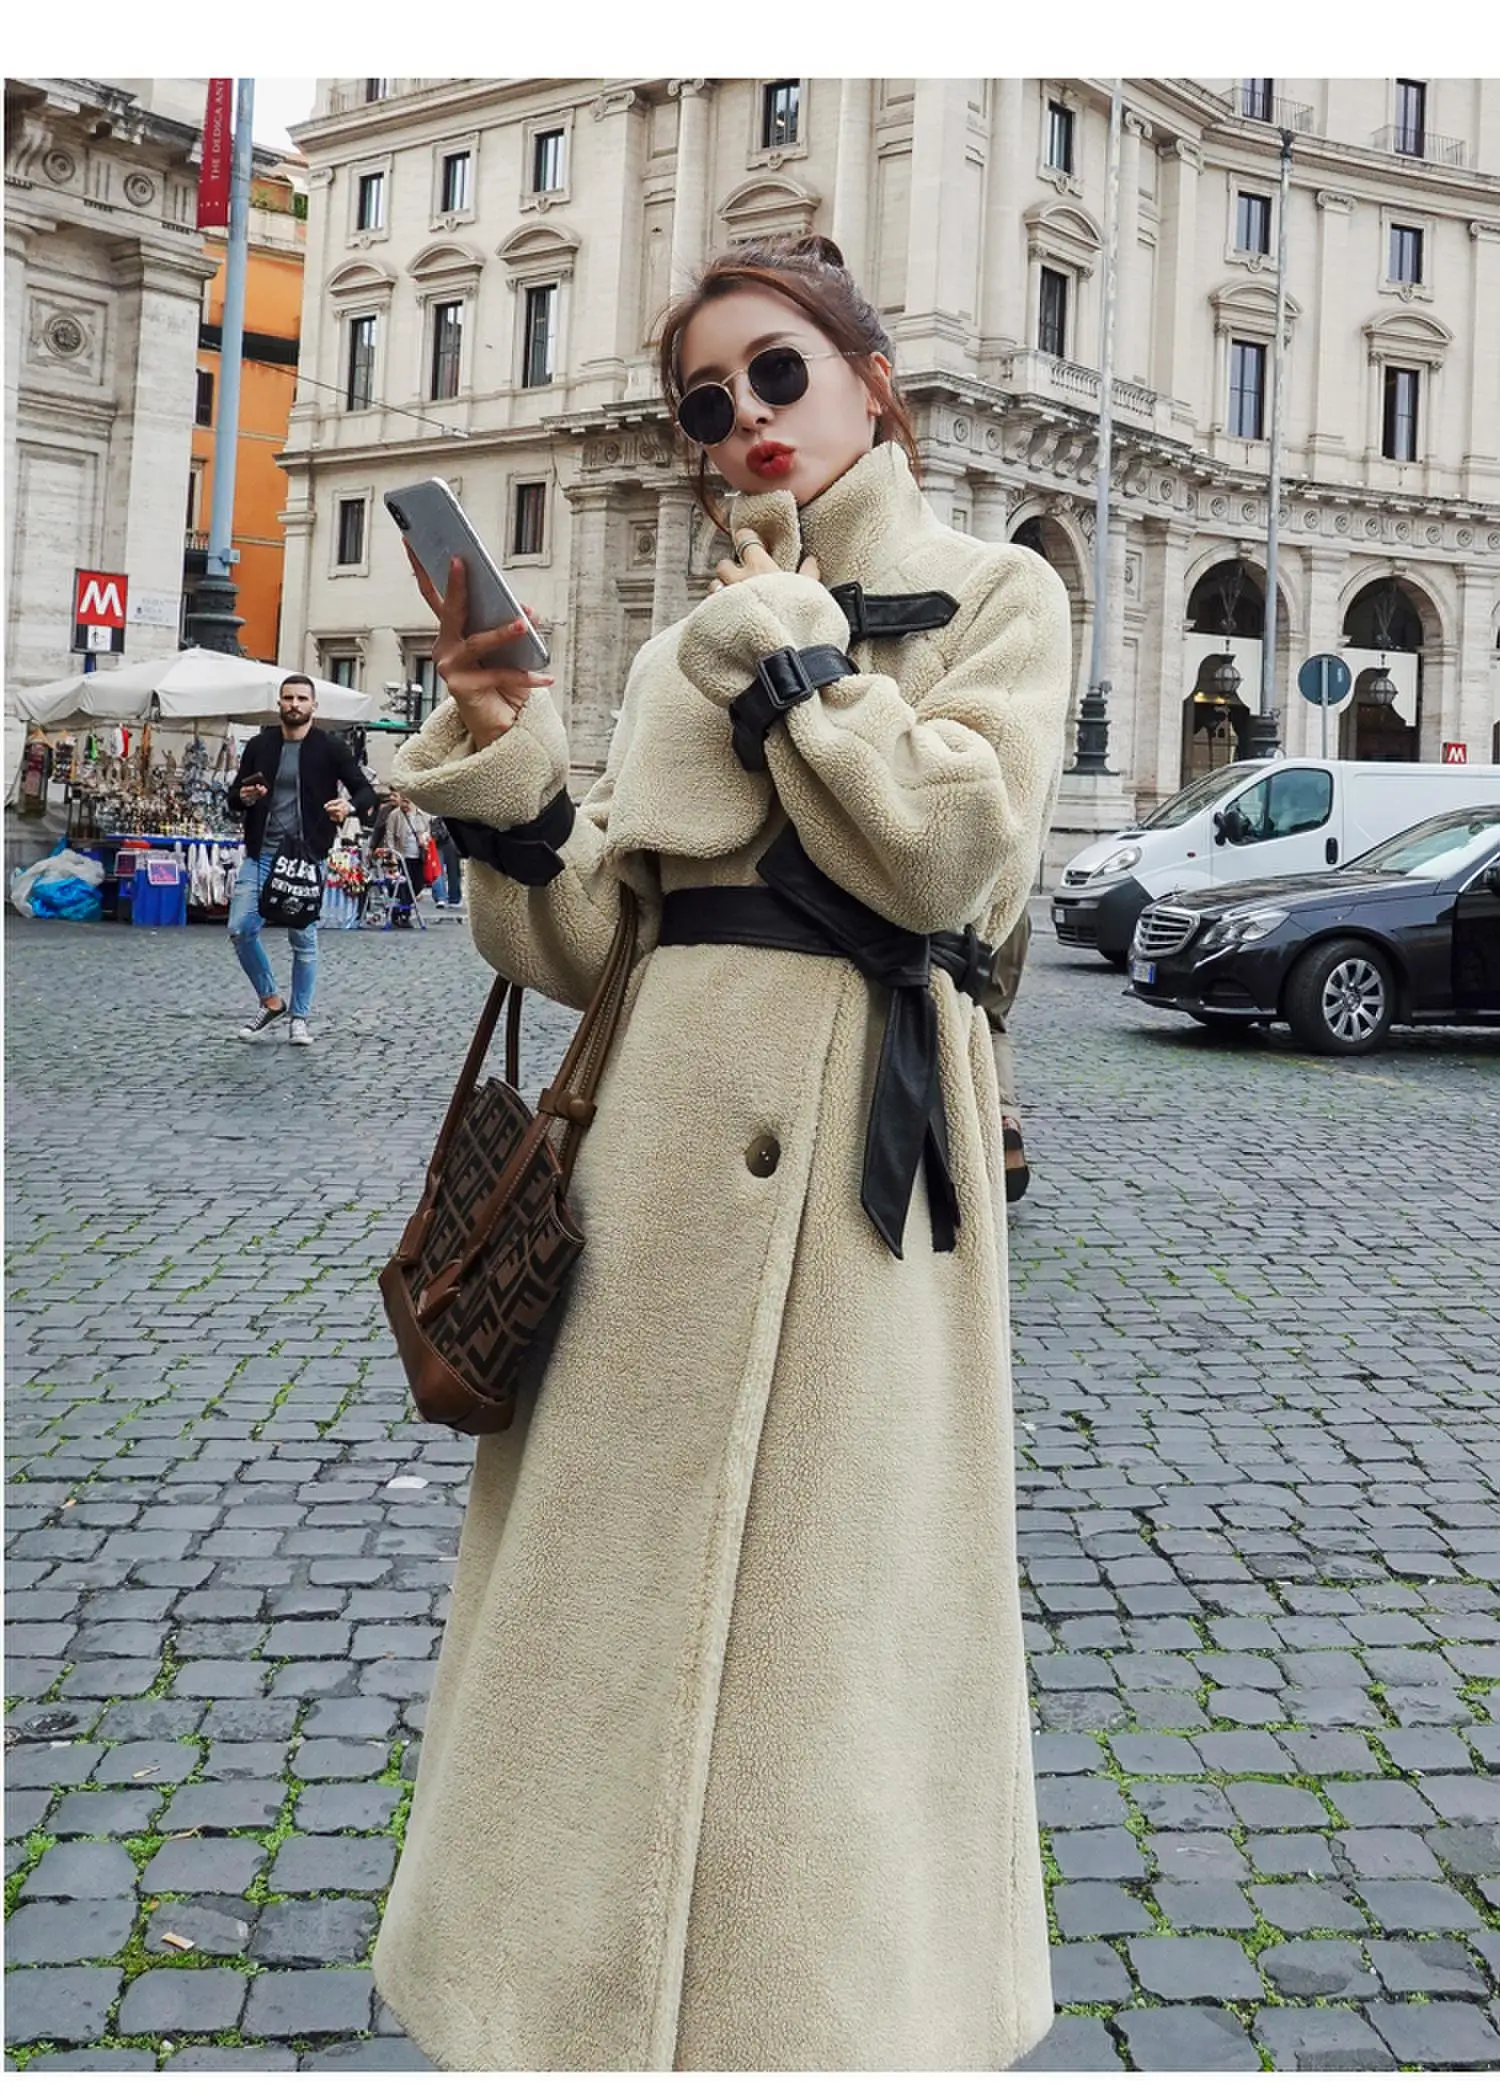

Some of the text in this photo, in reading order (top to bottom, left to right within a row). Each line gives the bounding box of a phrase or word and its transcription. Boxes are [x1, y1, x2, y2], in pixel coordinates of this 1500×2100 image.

[210, 158, 221, 181] THE
[80, 580, 123, 617] M
[1448, 747, 1465, 762] M
